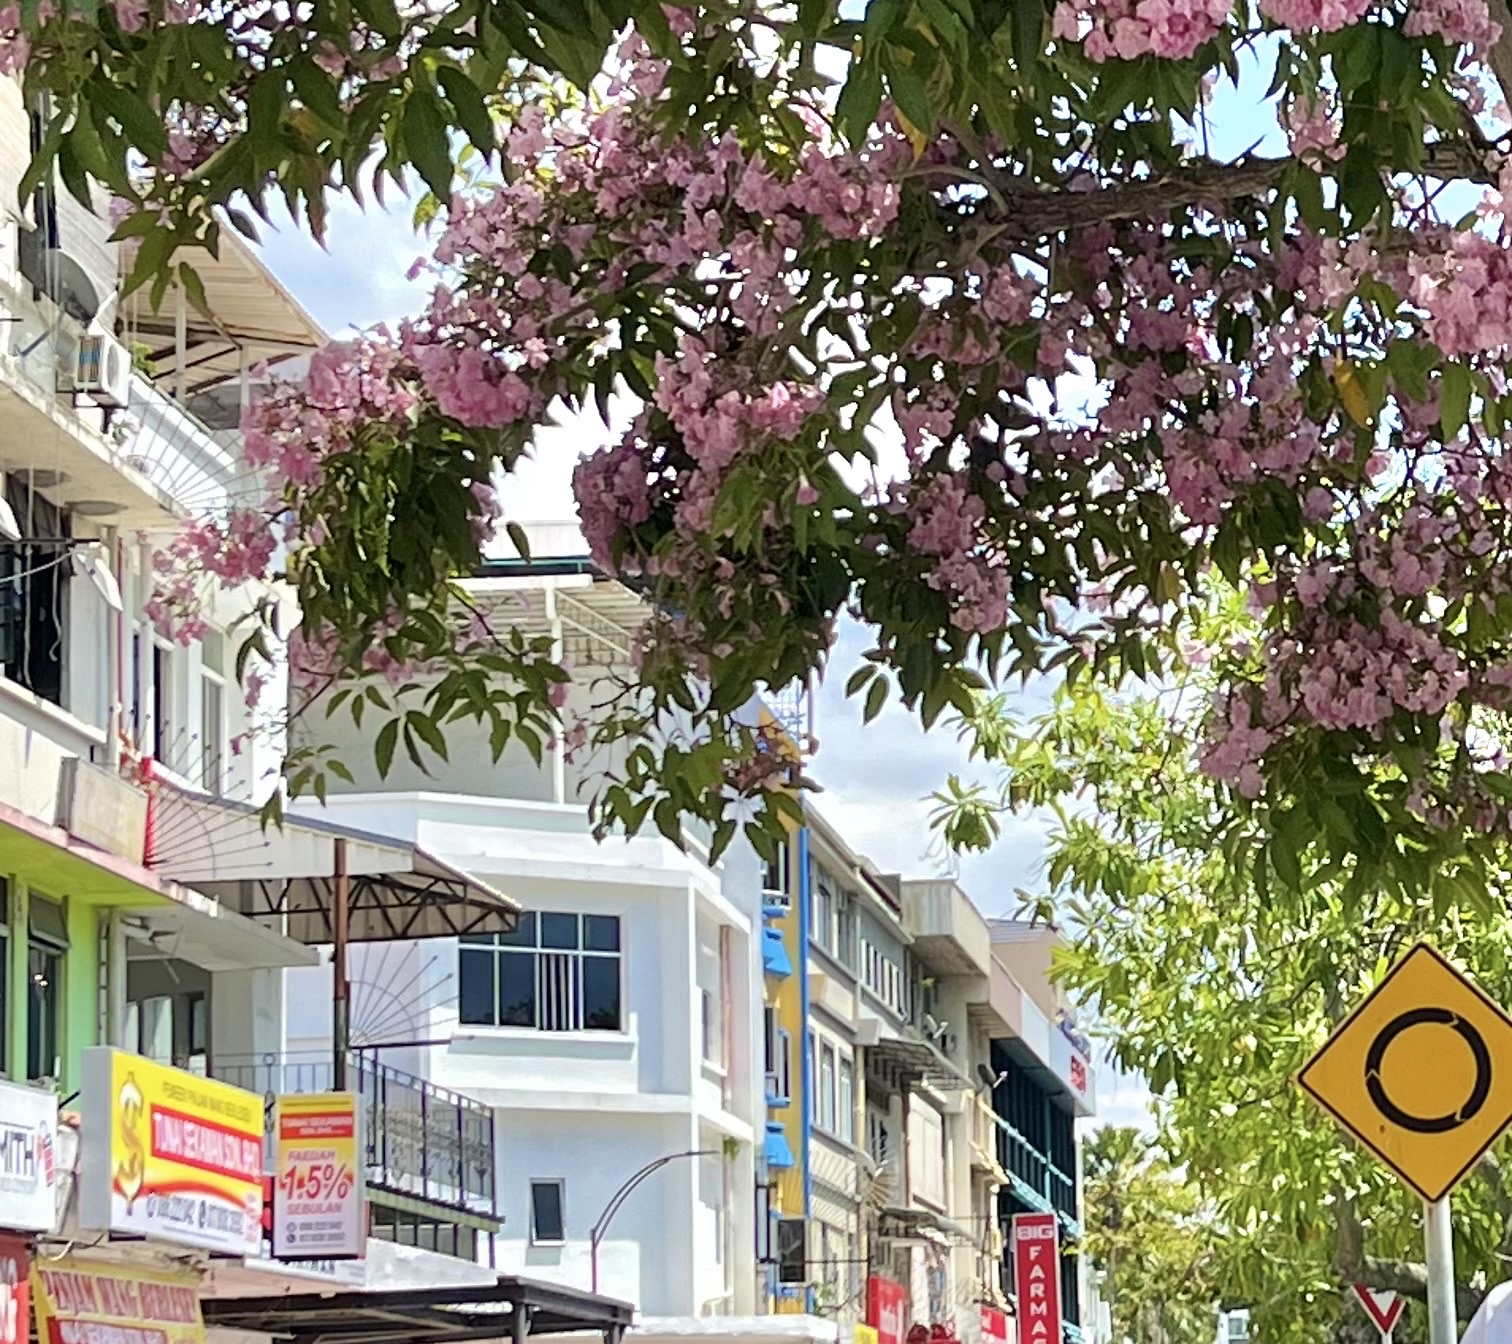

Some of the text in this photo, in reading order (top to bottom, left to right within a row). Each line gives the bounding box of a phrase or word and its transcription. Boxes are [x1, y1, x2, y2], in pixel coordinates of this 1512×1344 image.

[285, 1162, 348, 1200] 1.5%
[287, 1203, 342, 1215] SEBULAN
[1016, 1224, 1054, 1240] BIG
